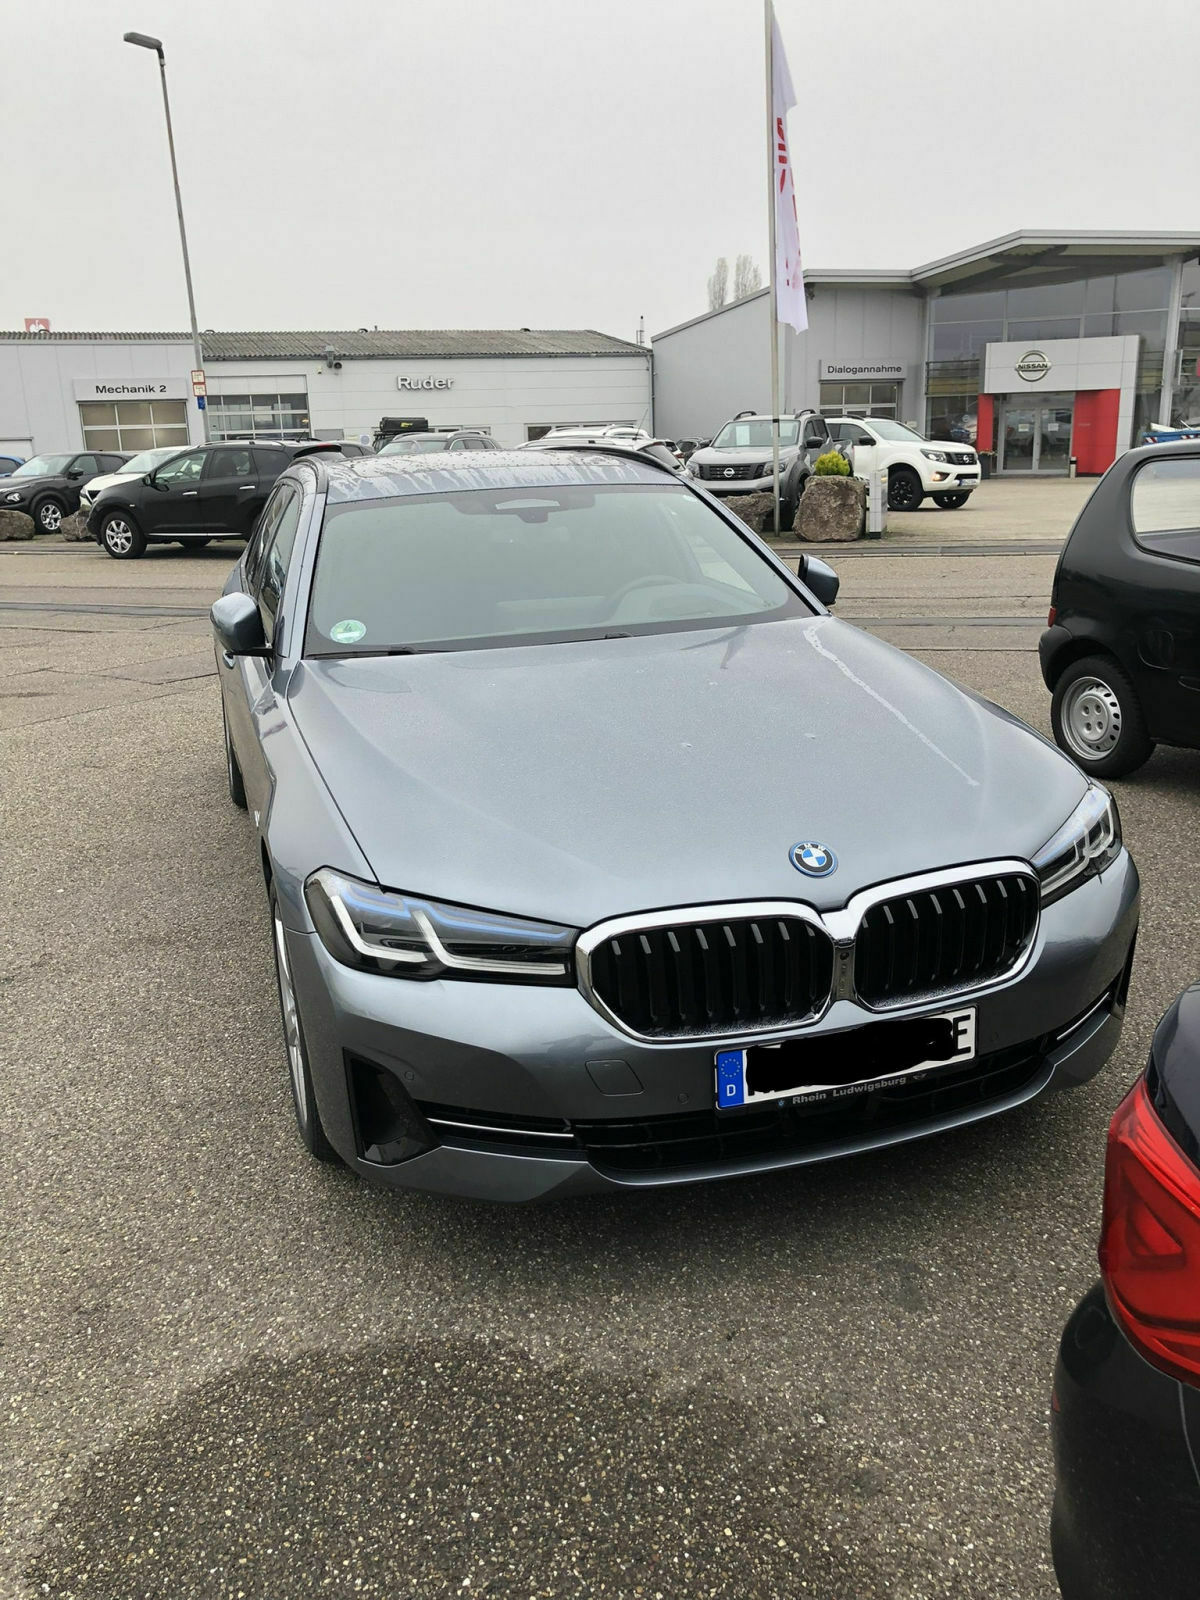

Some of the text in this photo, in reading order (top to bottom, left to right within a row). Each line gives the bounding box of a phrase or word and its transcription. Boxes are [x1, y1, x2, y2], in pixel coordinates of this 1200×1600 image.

[827, 365, 902, 375] Dialogannahme
[94, 384, 167, 394] Mechanik 2
[397, 375, 454, 391] Ruder
[726, 1084, 736, 1097] D
[792, 1076, 908, 1105] Rhein Ludwigsburg
